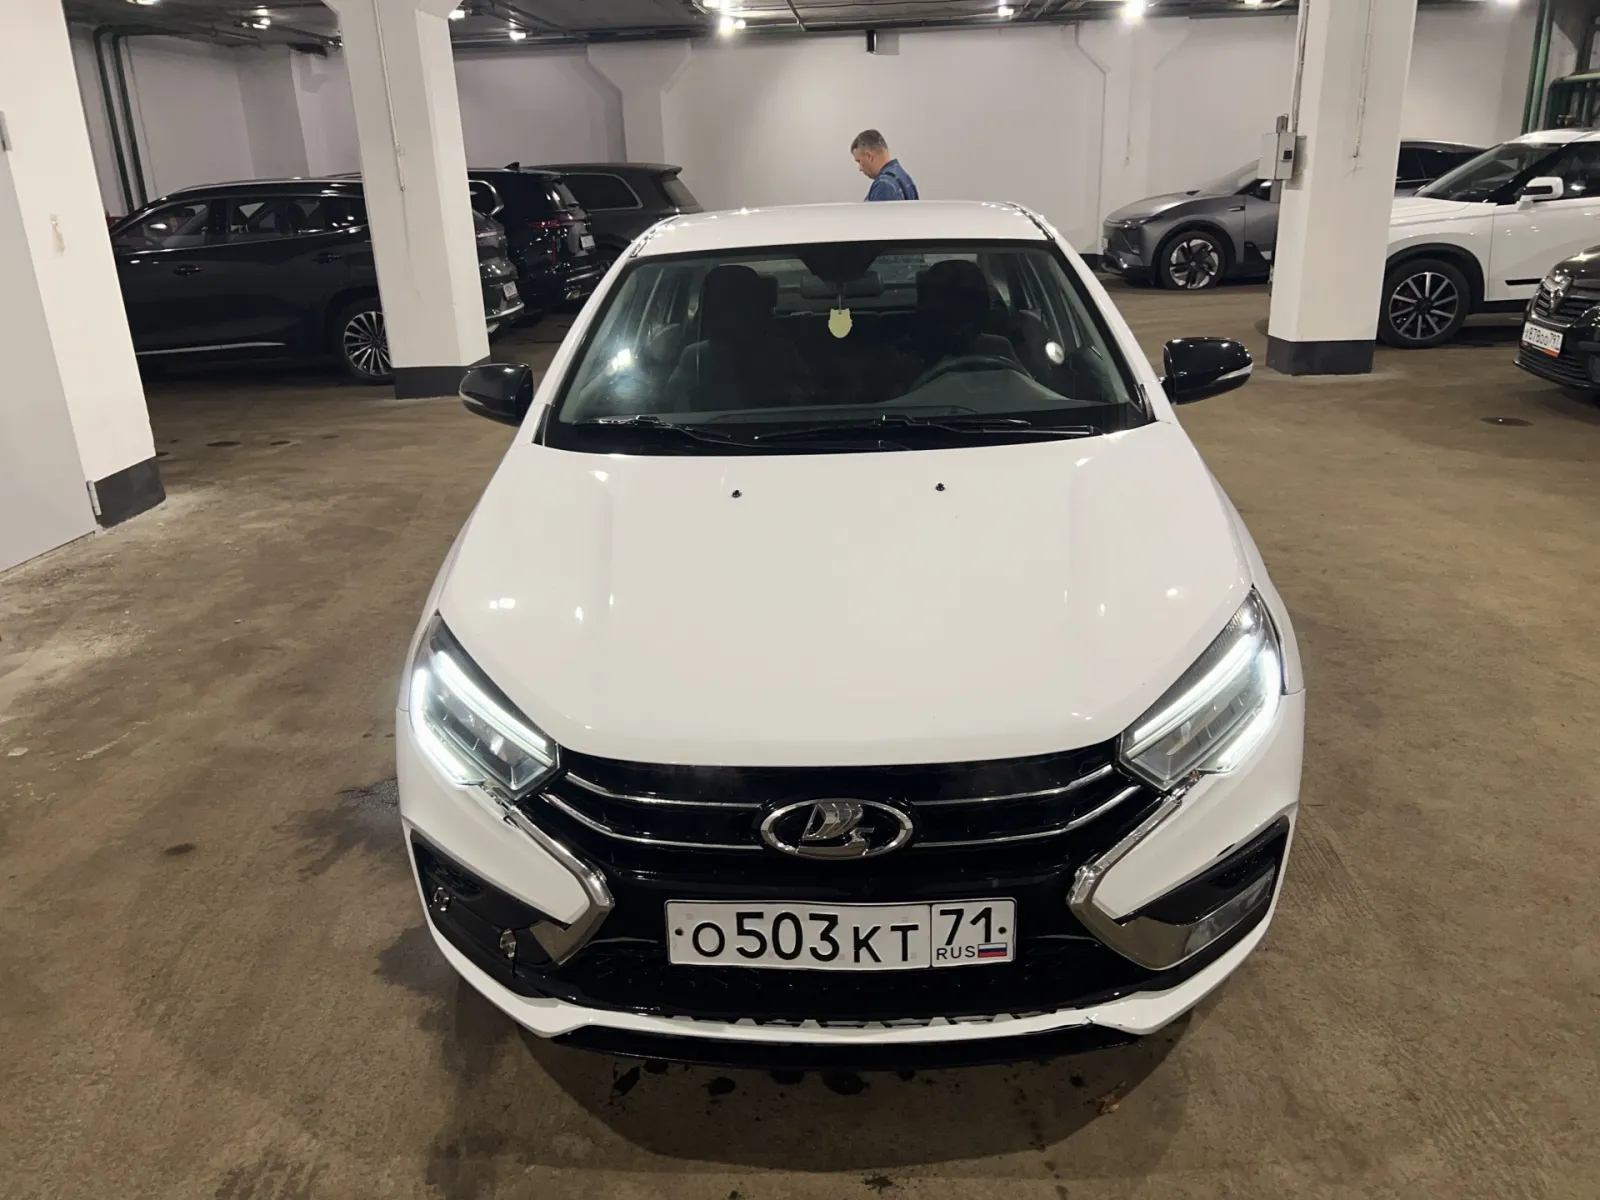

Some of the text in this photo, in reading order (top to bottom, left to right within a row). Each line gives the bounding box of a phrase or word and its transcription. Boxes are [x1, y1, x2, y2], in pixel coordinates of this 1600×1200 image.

[692, 907, 993, 963] О503КТ 71
[936, 945, 976, 960] RUS
